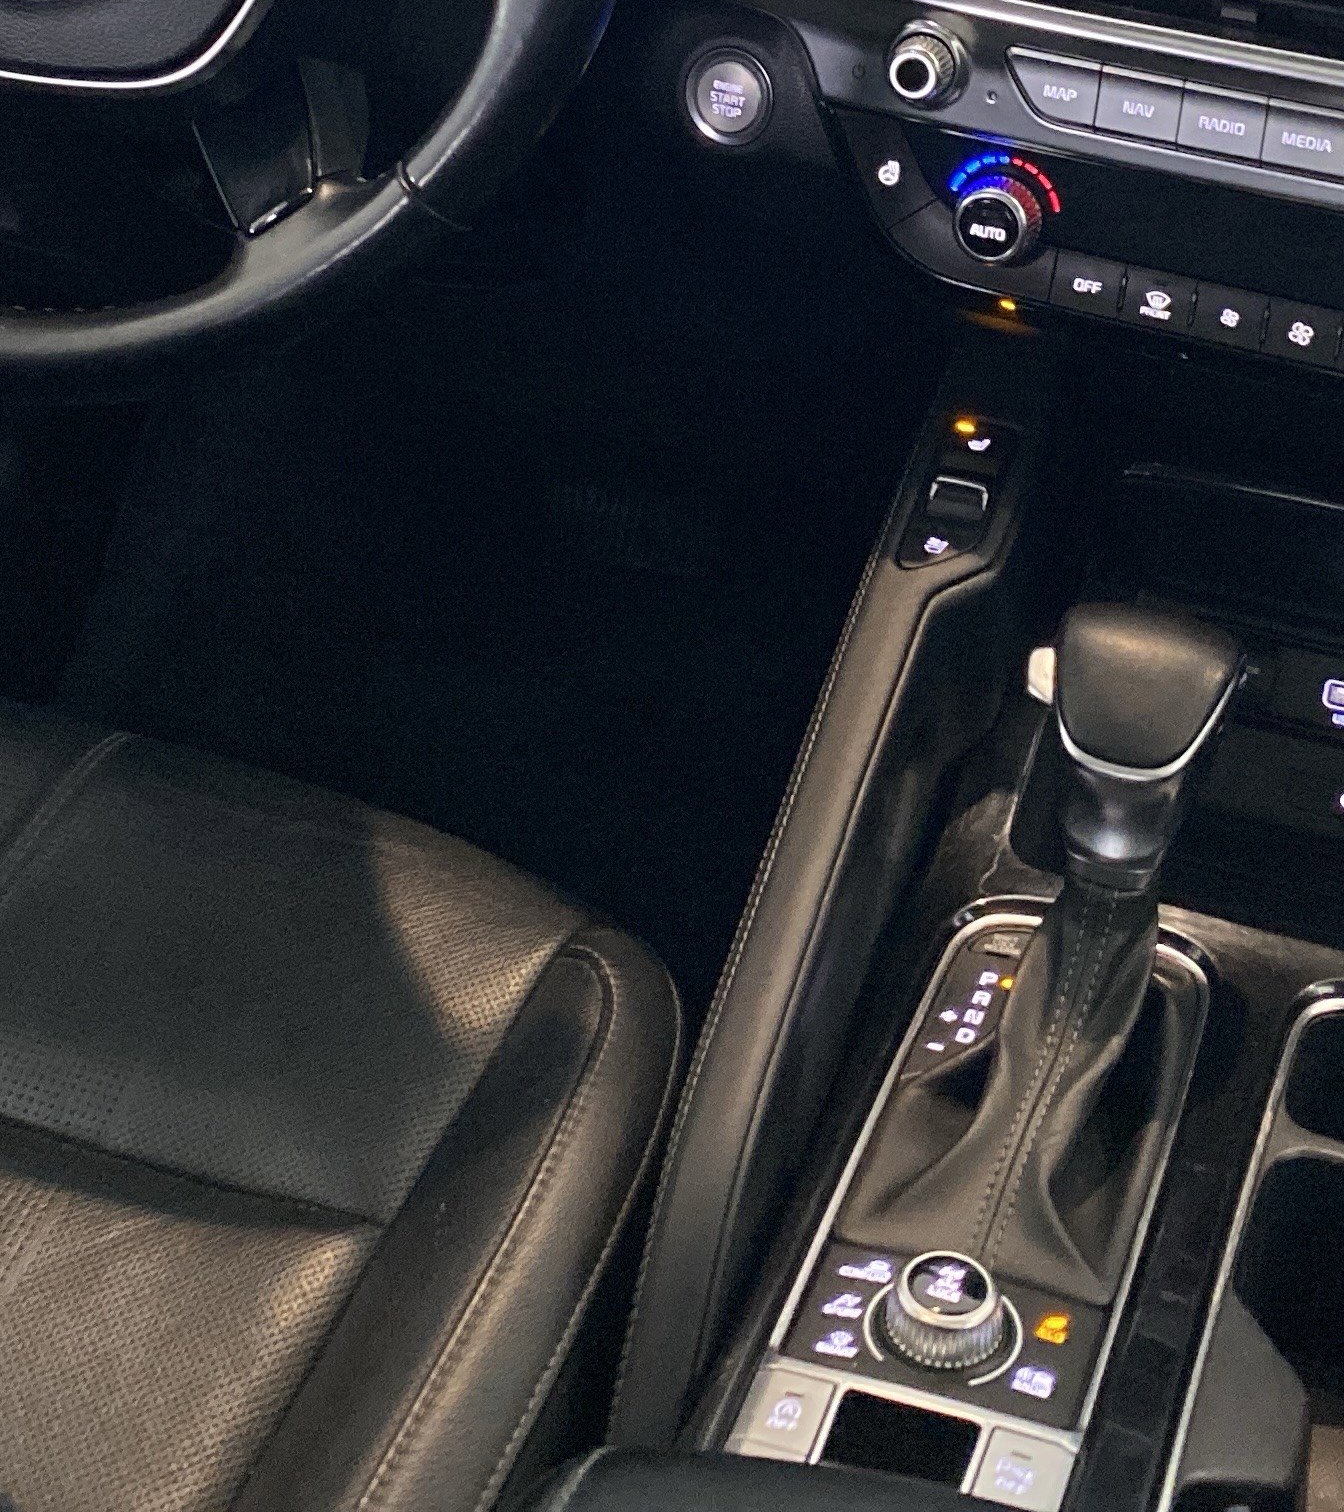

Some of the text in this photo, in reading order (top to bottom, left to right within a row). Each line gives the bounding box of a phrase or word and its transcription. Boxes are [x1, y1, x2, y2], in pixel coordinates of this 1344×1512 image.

[709, 90, 746, 107] START
[1043, 83, 1078, 104] MAP
[712, 103, 742, 118] STOP
[1122, 100, 1155, 119] NAV
[1198, 115, 1246, 137] RADIO
[1281, 131, 1332, 154] MEDIA
[969, 223, 1007, 243] AUTO
[1073, 277, 1103, 294] OFF
[979, 971, 999, 986] P
[962, 1008, 986, 1025] N
[955, 1027, 976, 1044] D
